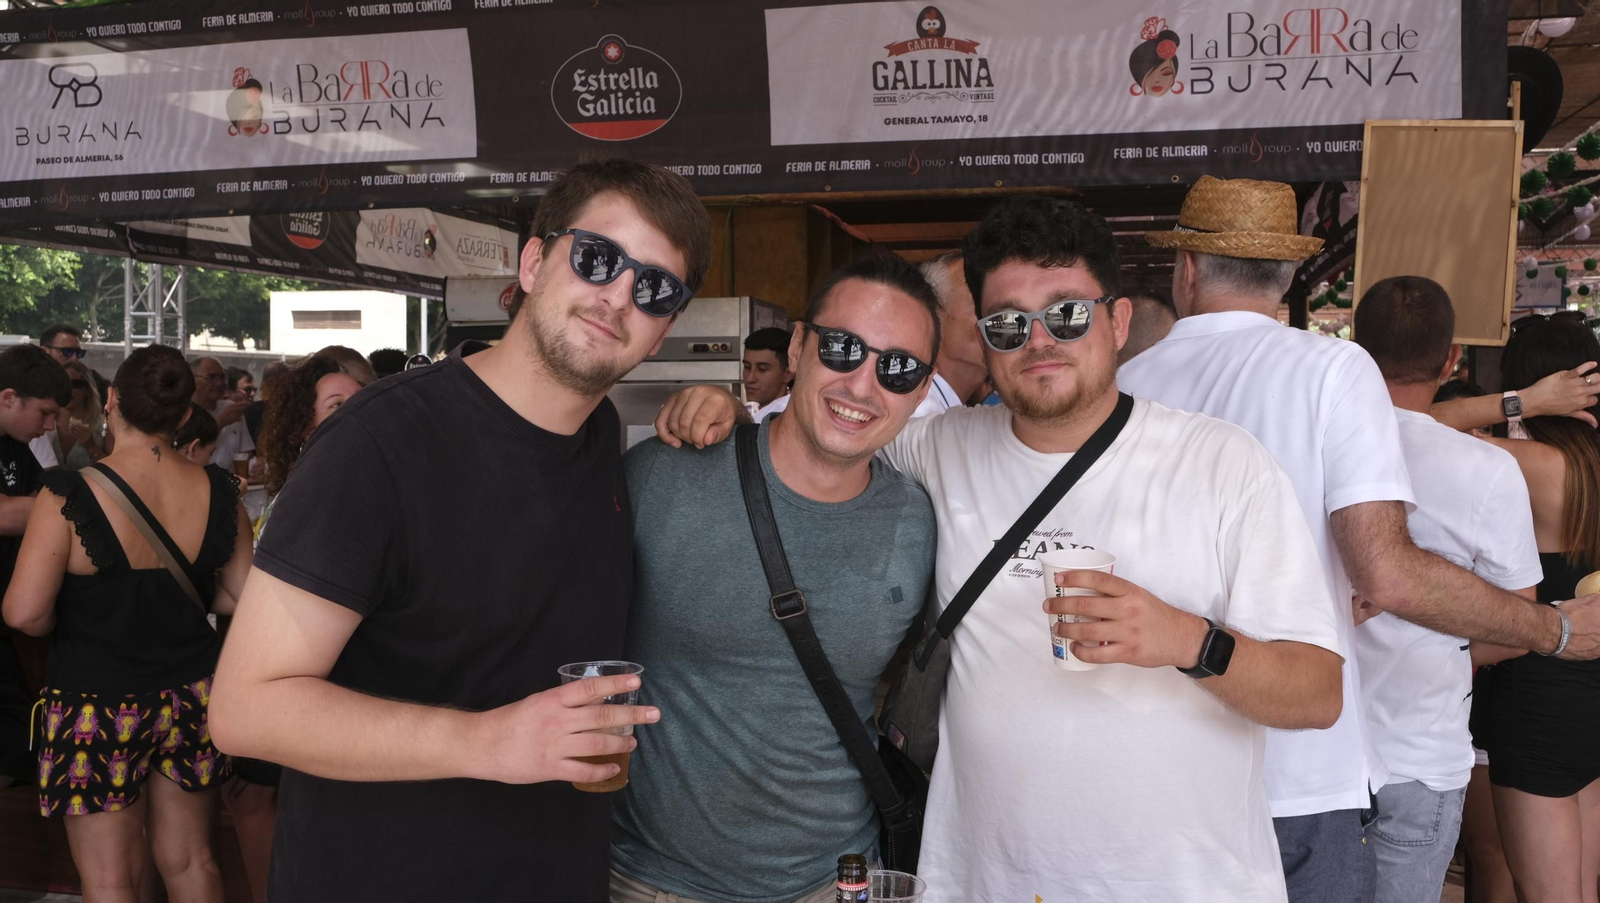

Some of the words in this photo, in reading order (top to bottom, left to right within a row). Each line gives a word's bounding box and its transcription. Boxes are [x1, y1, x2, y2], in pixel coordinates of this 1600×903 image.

[202, 16, 225, 28] FERIA
[226, 14, 237, 26] DE
[238, 11, 274, 24] ALMERIA
[346, 6, 359, 17] YO
[360, 4, 391, 16] QUIERO
[392, 2, 414, 14] TODO
[416, 0, 452, 12] CONTIGO
[86, 27, 97, 38] YO
[99, 25, 126, 36] QUIERO
[127, 23, 147, 34] TODO
[149, 20, 182, 32] CONTIGO
[907, 38, 939, 51] CANTA
[944, 39, 956, 50] LA
[1190, 33, 1218, 60] La
[1380, 23, 1419, 51] de
[572, 67, 659, 92] Estrella
[872, 58, 994, 91] GALLINA
[1190, 55, 1419, 94] BURANA
[270, 82, 293, 104] La
[415, 74, 443, 98] de
[873, 96, 897, 104] COCKTAIL
[969, 93, 994, 101] VINTAGE
[577, 91, 657, 117] Galicia
[272, 102, 445, 135] BURANA
[884, 117, 929, 125] GENERAL
[931, 115, 976, 124] TAMAYO,
[978, 115, 988, 123] 18
[15, 121, 142, 146] BURANA
[36, 157, 62, 165] PASEO
[63, 156, 74, 164] DE
[75, 155, 113, 164] ALMERIA,
[114, 154, 124, 162] 56
[1114, 147, 1142, 159] FERIA
[1146, 147, 1159, 158] DE
[1162, 145, 1208, 157] ALMERIA
[1307, 141, 1321, 153] YO
[1325, 140, 1363, 153] QUIERO
[697, 164, 722, 176] TODO
[723, 163, 762, 175] CONTIGO
[786, 162, 812, 173] FERIA
[814, 161, 827, 172] DE
[829, 160, 870, 171] ALMERIA
[959, 156, 972, 167] YO
[975, 155, 1010, 166] QUIERO
[1013, 154, 1038, 165] TODO
[1042, 153, 1084, 164] CONTIGO
[217, 182, 238, 193] FERIA
[240, 181, 250, 192] DE
[252, 180, 288, 191] ALMERIA
[361, 176, 372, 186] YO
[374, 175, 404, 186] QUIERO
[406, 174, 427, 184] TODO
[429, 172, 465, 183] CONTIGO
[490, 173, 514, 184] FERIA
[516, 172, 528, 183] DE
[99, 193, 110, 203] YO
[111, 191, 139, 202] QUIERO
[141, 190, 161, 200] TODO
[162, 187, 195, 198] CONTIGO
